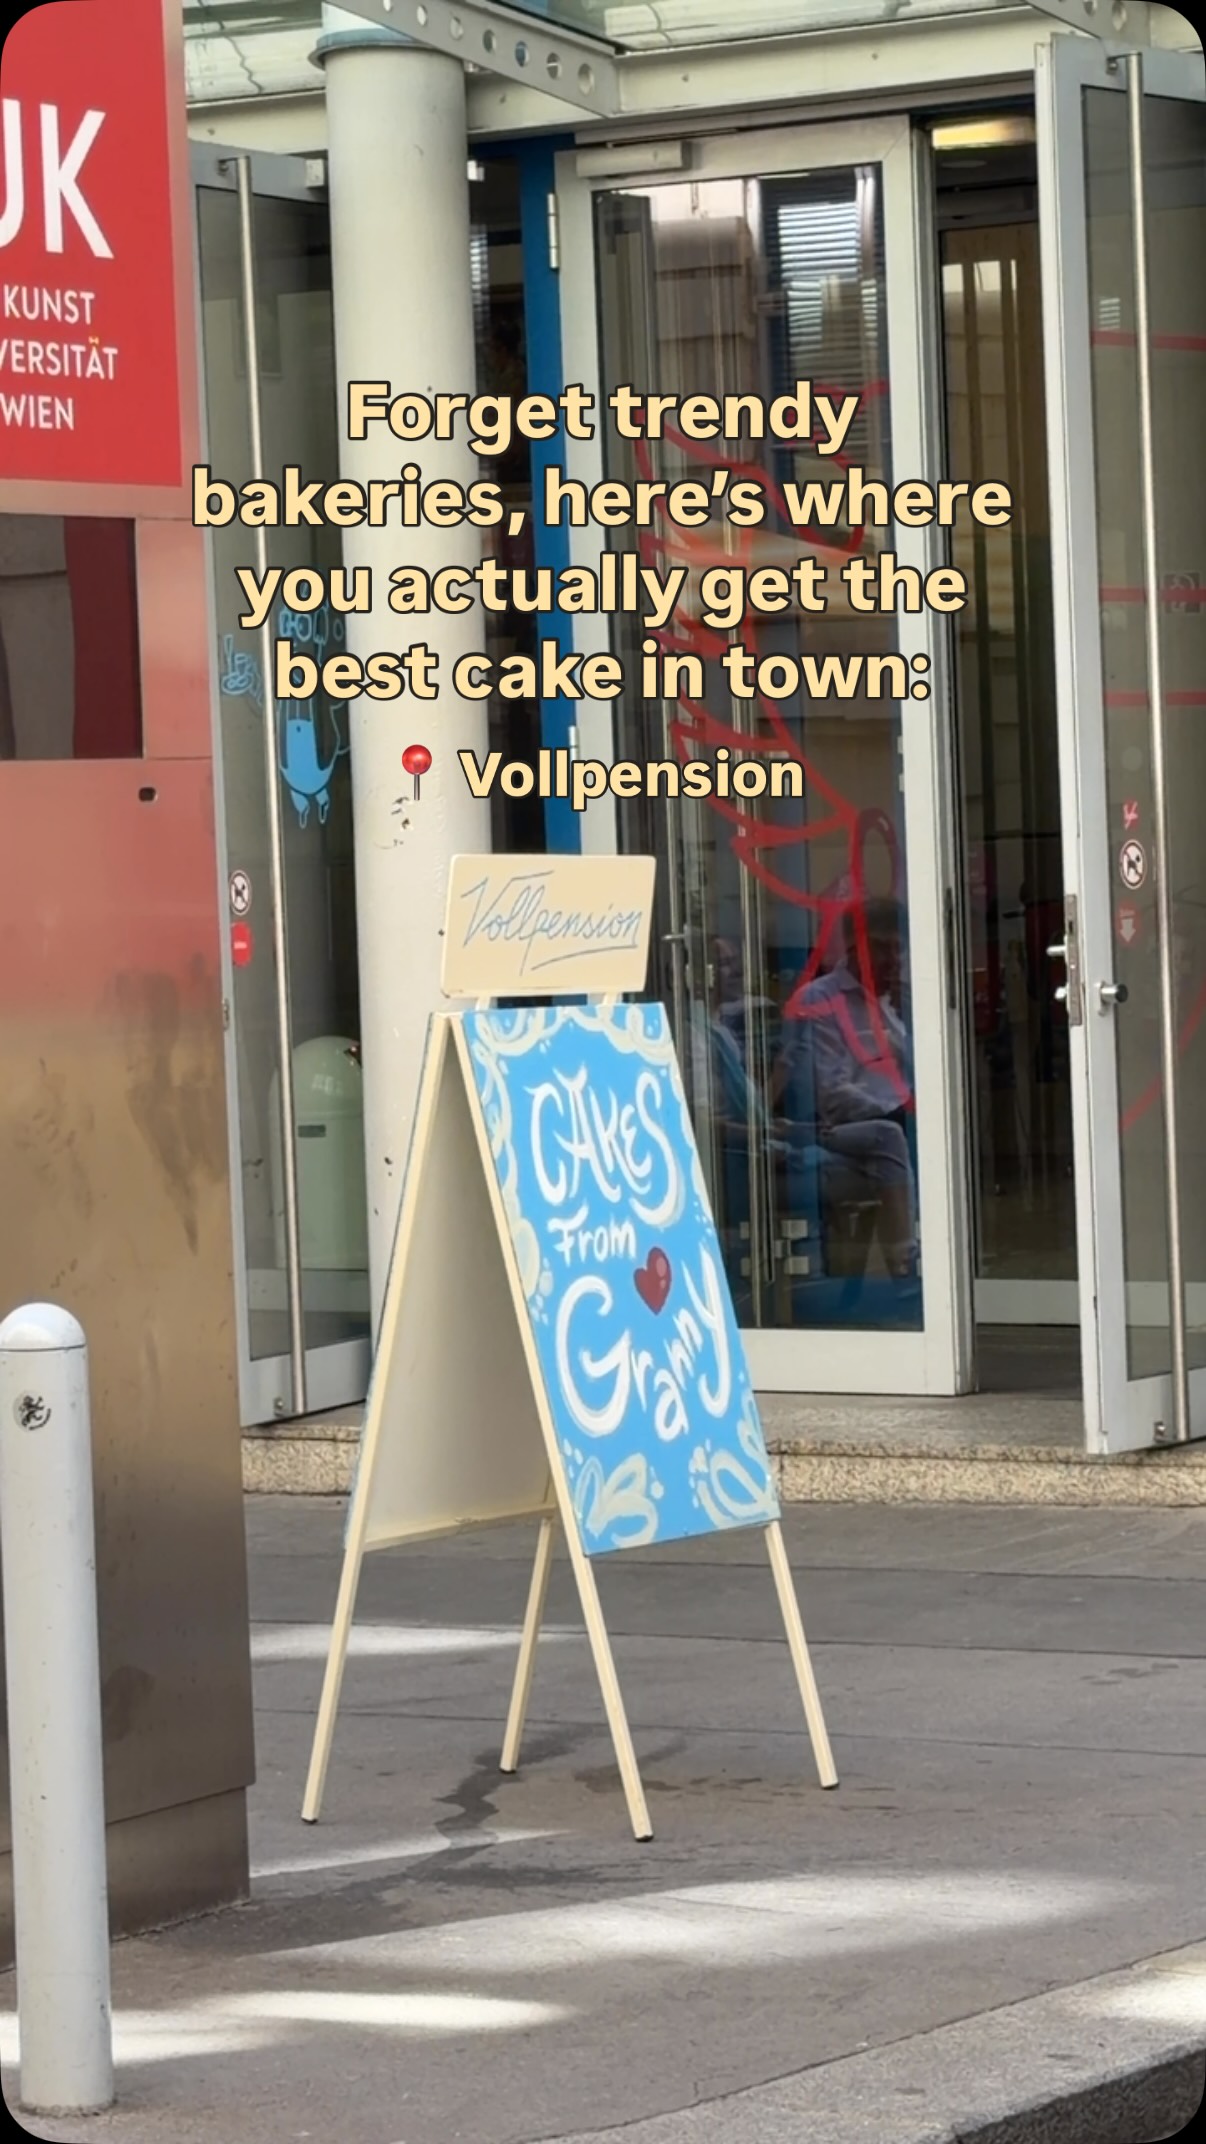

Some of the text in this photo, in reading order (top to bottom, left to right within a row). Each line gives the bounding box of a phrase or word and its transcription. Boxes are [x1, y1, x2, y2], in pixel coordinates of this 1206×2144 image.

[3, 284, 96, 326] KUNST
[0, 393, 75, 431] WIEN
[460, 869, 643, 977] Vollpension
[523, 1061, 684, 1230] CAKES
[547, 1201, 637, 1266] From
[555, 1240, 731, 1441] Granny
